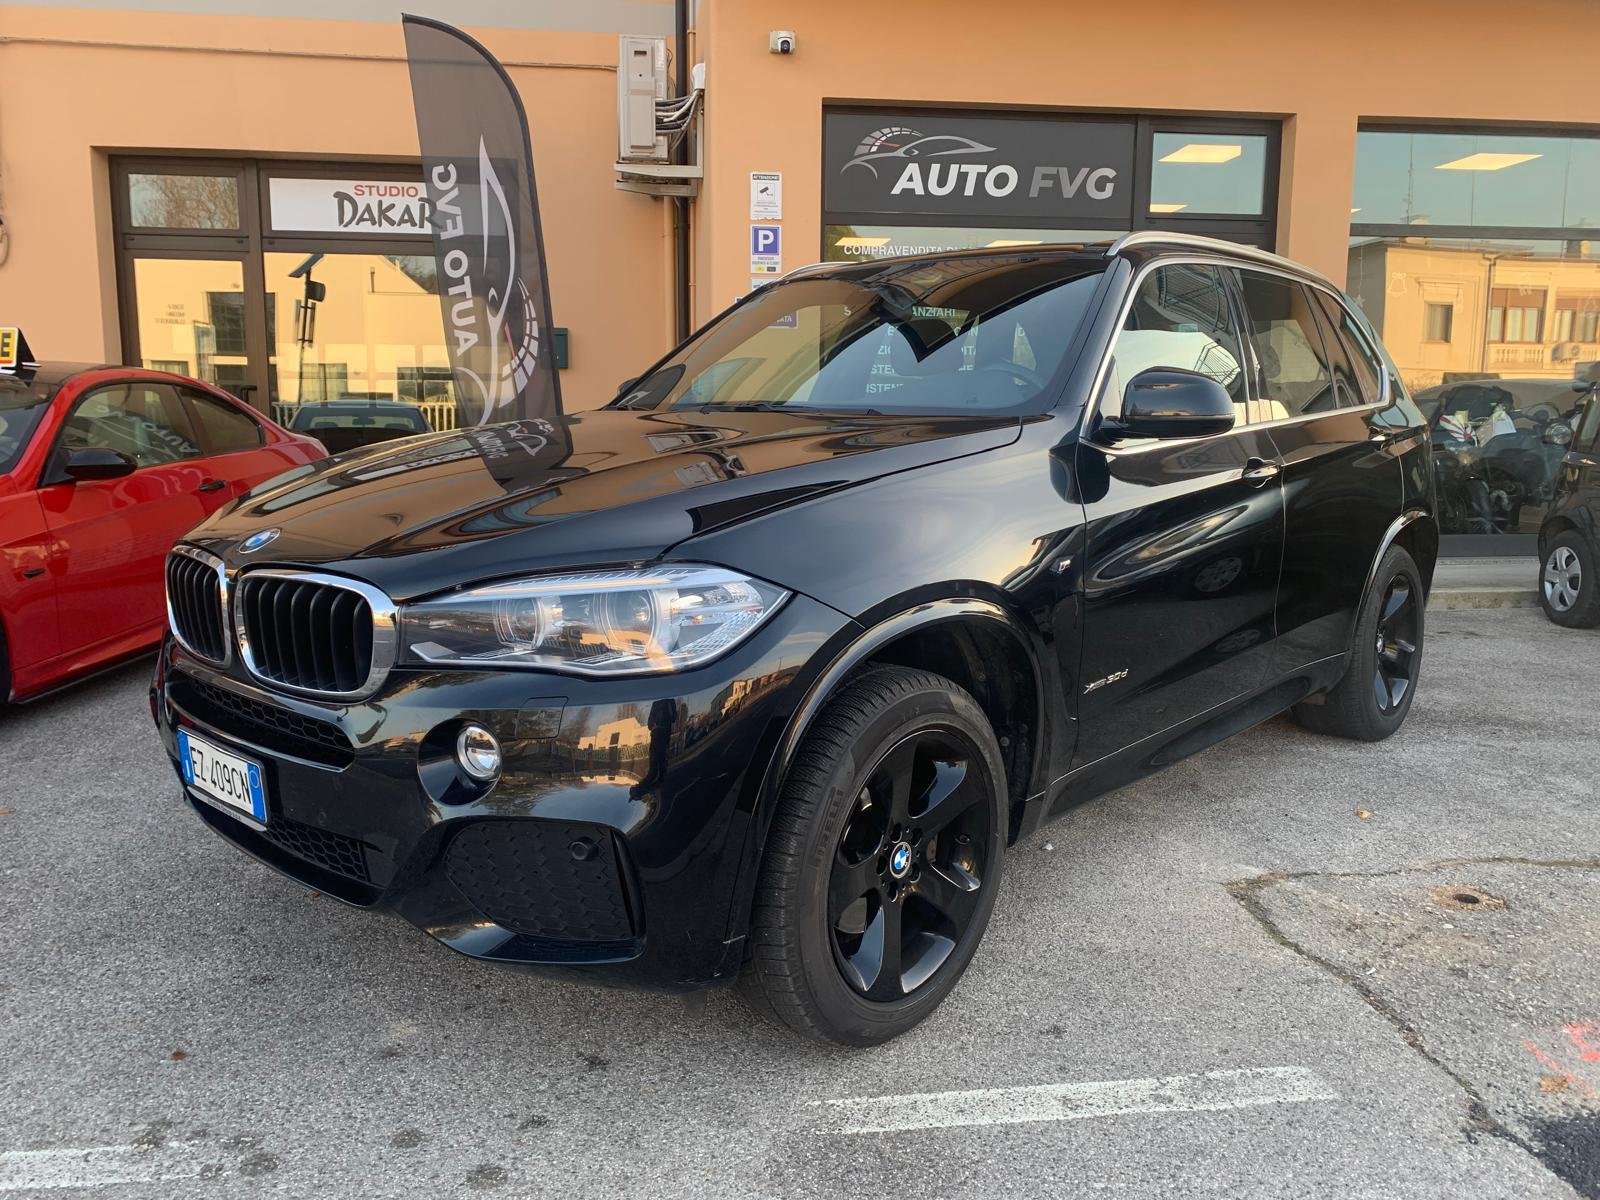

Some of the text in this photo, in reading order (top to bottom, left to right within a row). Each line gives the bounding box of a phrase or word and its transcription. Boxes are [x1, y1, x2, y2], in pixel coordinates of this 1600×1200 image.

[354, 184, 419, 198] STUDIO
[891, 162, 1118, 200] AUTO FVG
[333, 190, 443, 229] DAKAR
[758, 229, 775, 252] P
[190, 746, 252, 805] EZ 409CN
